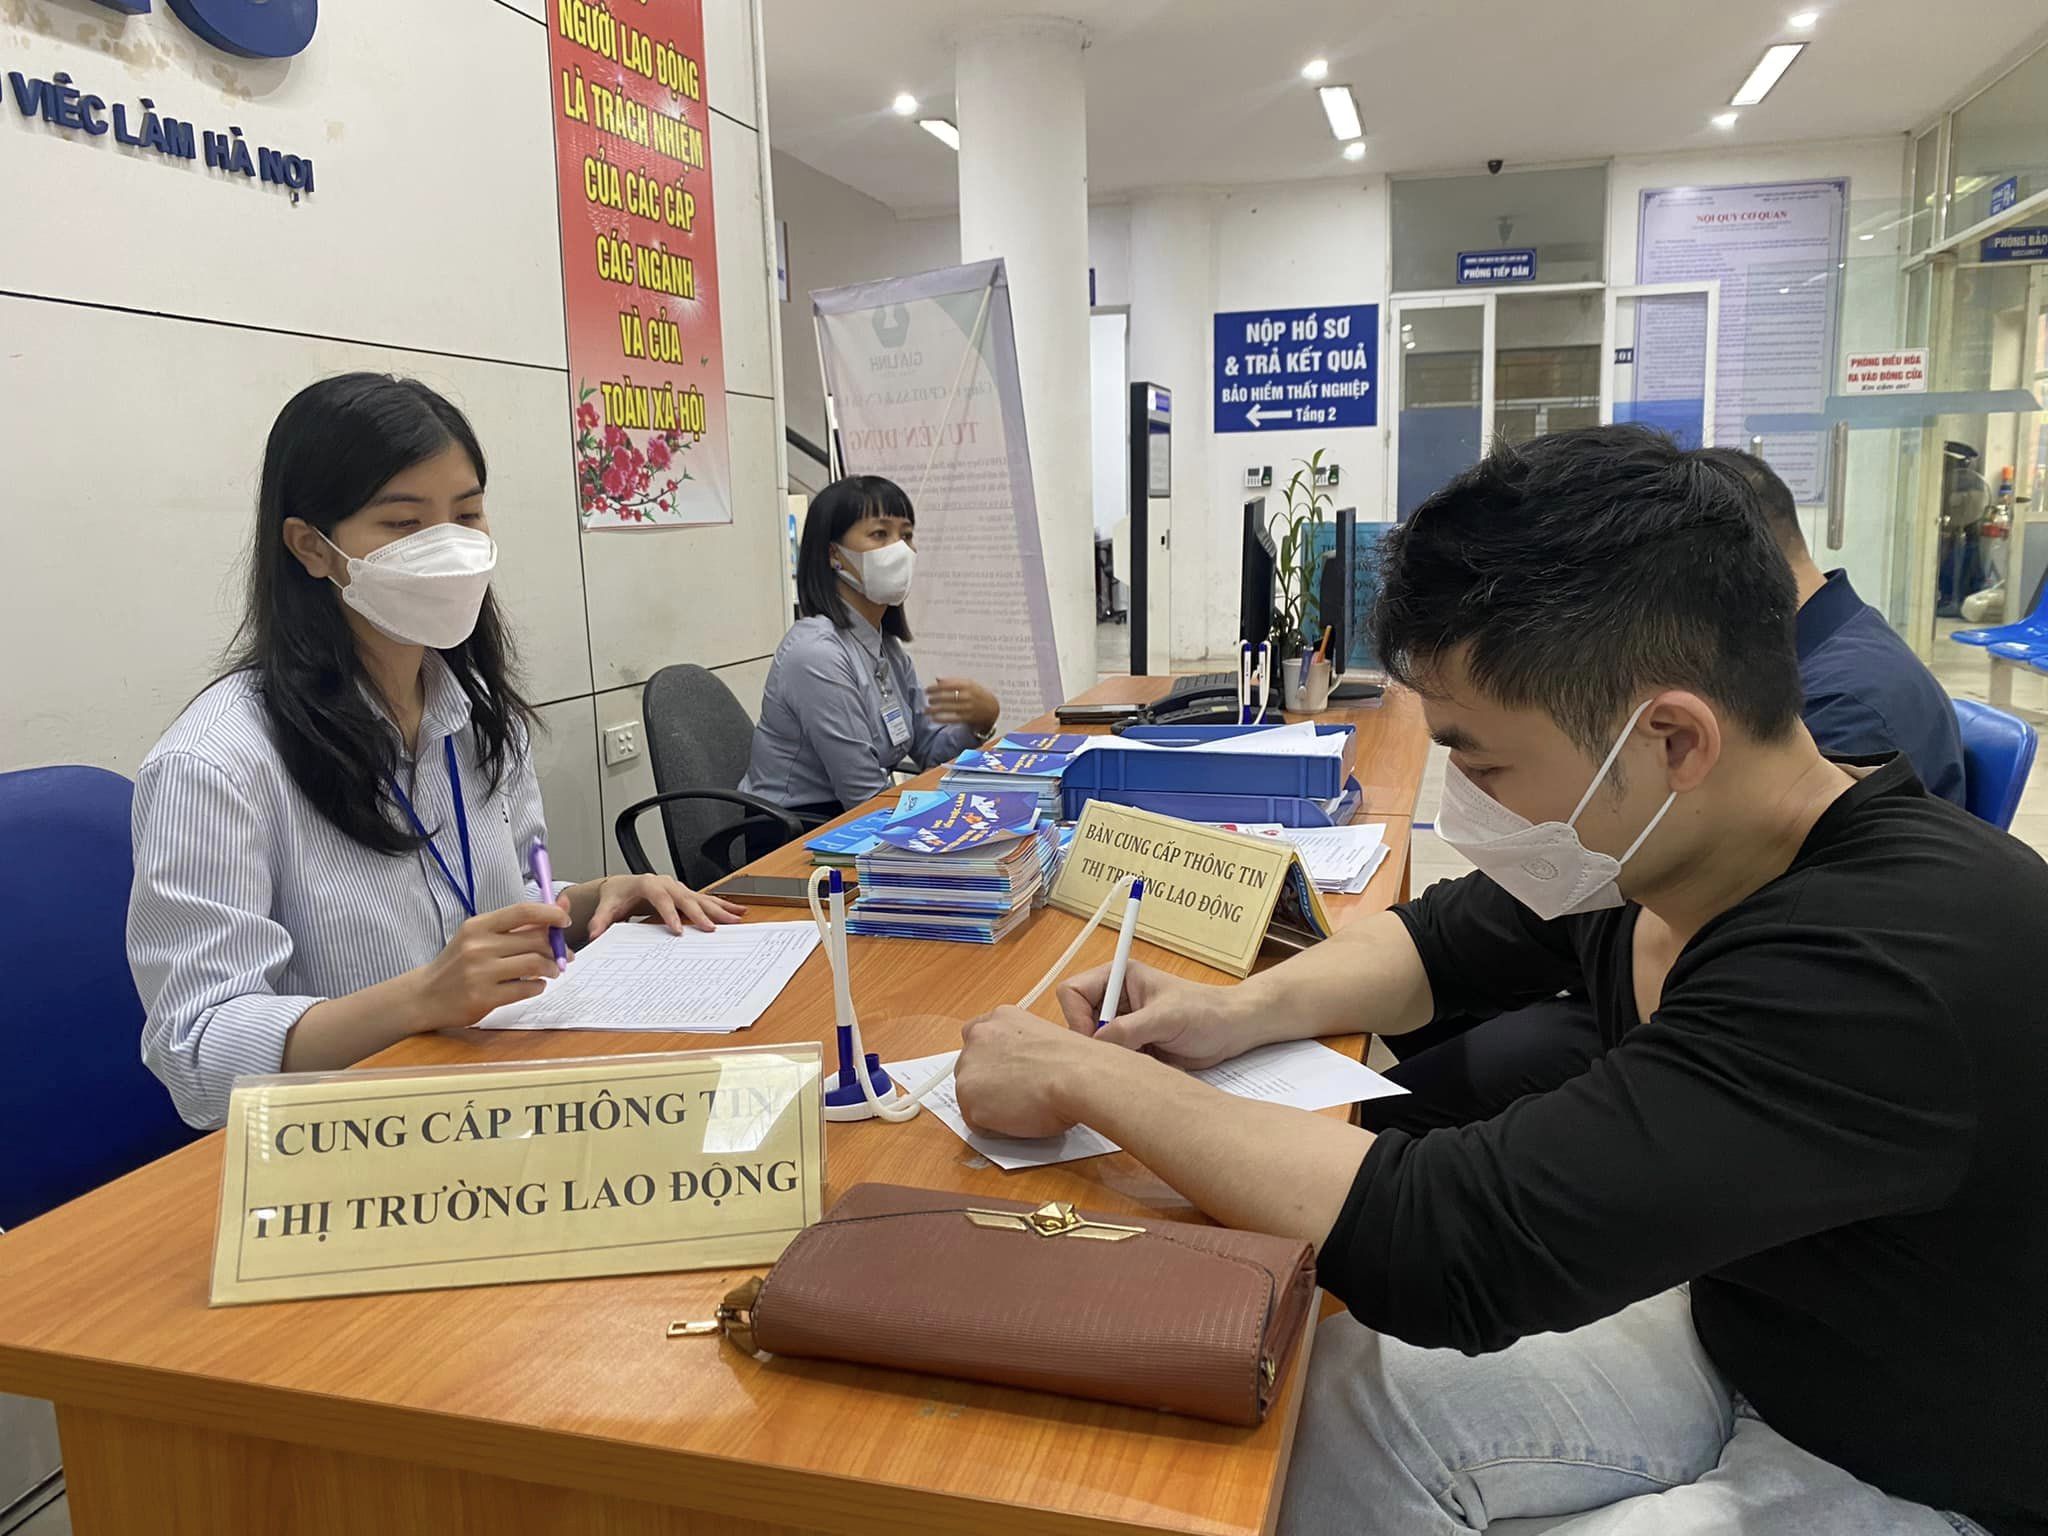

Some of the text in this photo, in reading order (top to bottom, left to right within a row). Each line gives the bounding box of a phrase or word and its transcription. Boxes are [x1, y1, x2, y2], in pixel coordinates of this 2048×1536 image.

[558, 0, 701, 103] NGƯỜI LAO ĐỘNG
[112, 98, 197, 160] LÀM
[203, 126, 256, 177] HÀ
[562, 63, 705, 172] LÀ TRÁCH NHIỆM
[583, 145, 696, 232] CỦA CÁC CẤP
[1717, 211, 1738, 223] QUY
[1758, 210, 1788, 222] QUAN
[596, 229, 696, 300] CÁC NGÀNH
[1463, 266, 1491, 280] PHÒNG
[1493, 264, 1510, 278] TIẾP
[619, 305, 684, 365] VÀ CỦA
[1225, 342, 1367, 376] & TRẢ KẾT QUẢ
[1246, 318, 1286, 347] NỘP
[1324, 315, 1351, 339] SƠ
[600, 373, 707, 441] TOÀN XÃ HỘI
[1222, 378, 1370, 402] BẢO HIỂM THẤT NGHIỆP
[1848, 373, 1858, 382] RA
[1328, 407, 1336, 421] 2
[1085, 823, 1268, 889] BÀN CUNG CẤP THÔNG TIN
[1080, 858, 1243, 924] THỊ TRNG LAO ĐỘNG
[275, 1086, 776, 1157] CUNG CẤP THÔNG TIN
[249, 1160, 799, 1243] THỊ TRƯỜNG LAO ĐỘNG
